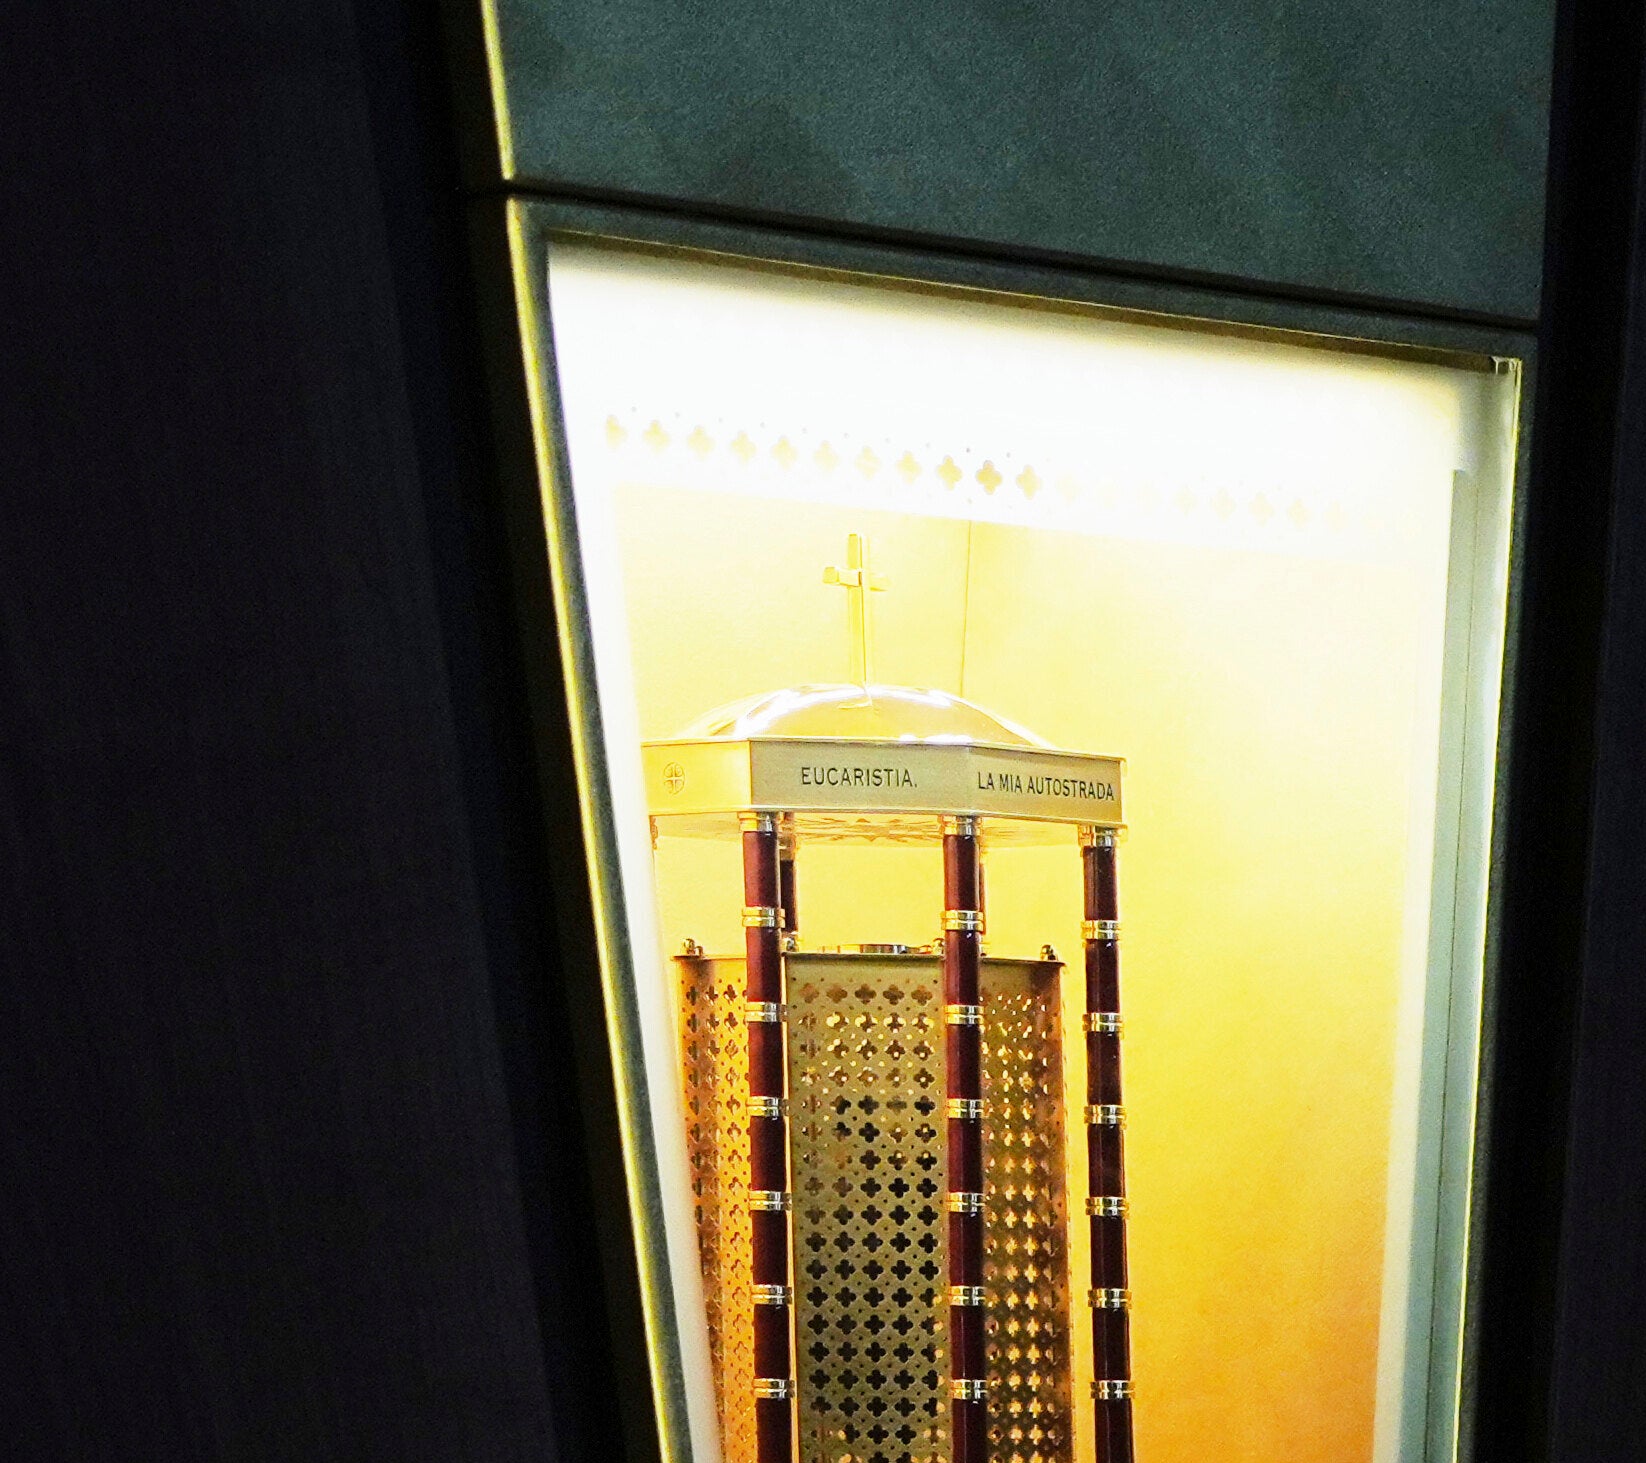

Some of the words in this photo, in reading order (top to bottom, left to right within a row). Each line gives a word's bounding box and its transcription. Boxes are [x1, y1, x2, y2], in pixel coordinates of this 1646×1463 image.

[801, 767, 917, 788] EUCARISTIA.
[978, 771, 995, 791] LA
[1000, 773, 1022, 793] MIA
[1027, 776, 1115, 800] AUTOSTRADA
